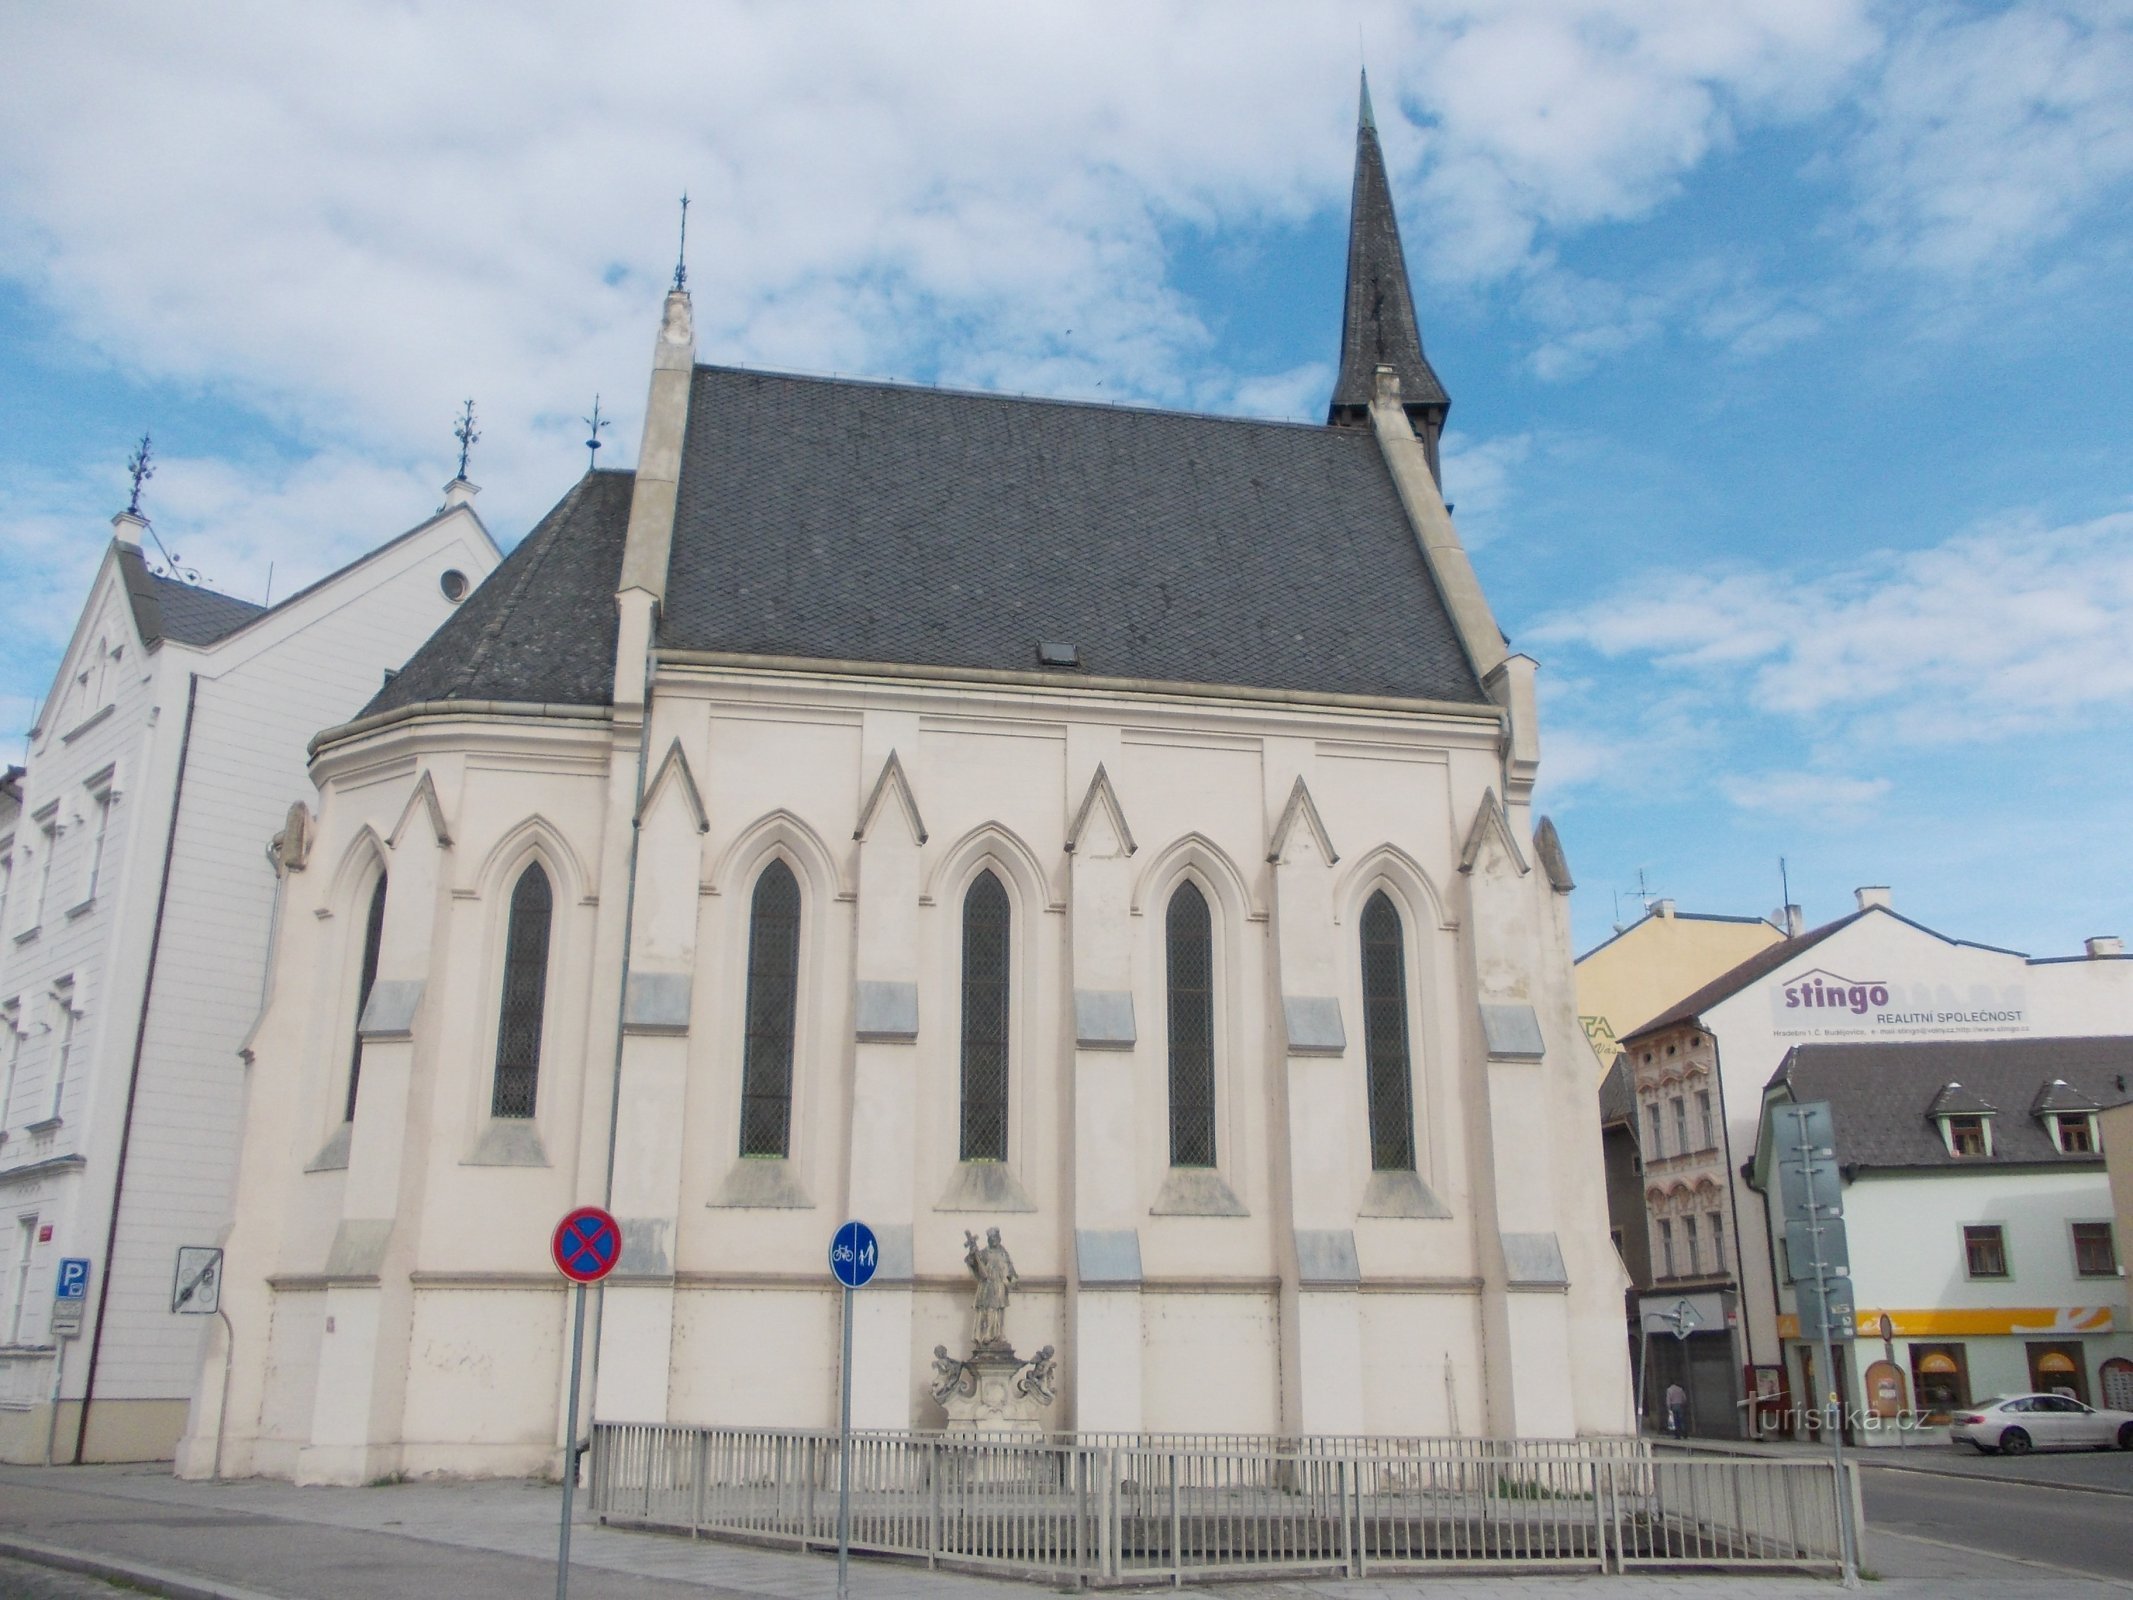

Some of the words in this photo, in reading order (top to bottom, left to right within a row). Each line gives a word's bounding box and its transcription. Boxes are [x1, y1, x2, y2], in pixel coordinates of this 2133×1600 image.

[1785, 978, 1889, 1014] stingo
[1877, 1010, 1934, 1024] REALITNÍ
[1937, 1008, 2023, 1023] SPOLEČNOST
[64, 1263, 83, 1286] P
